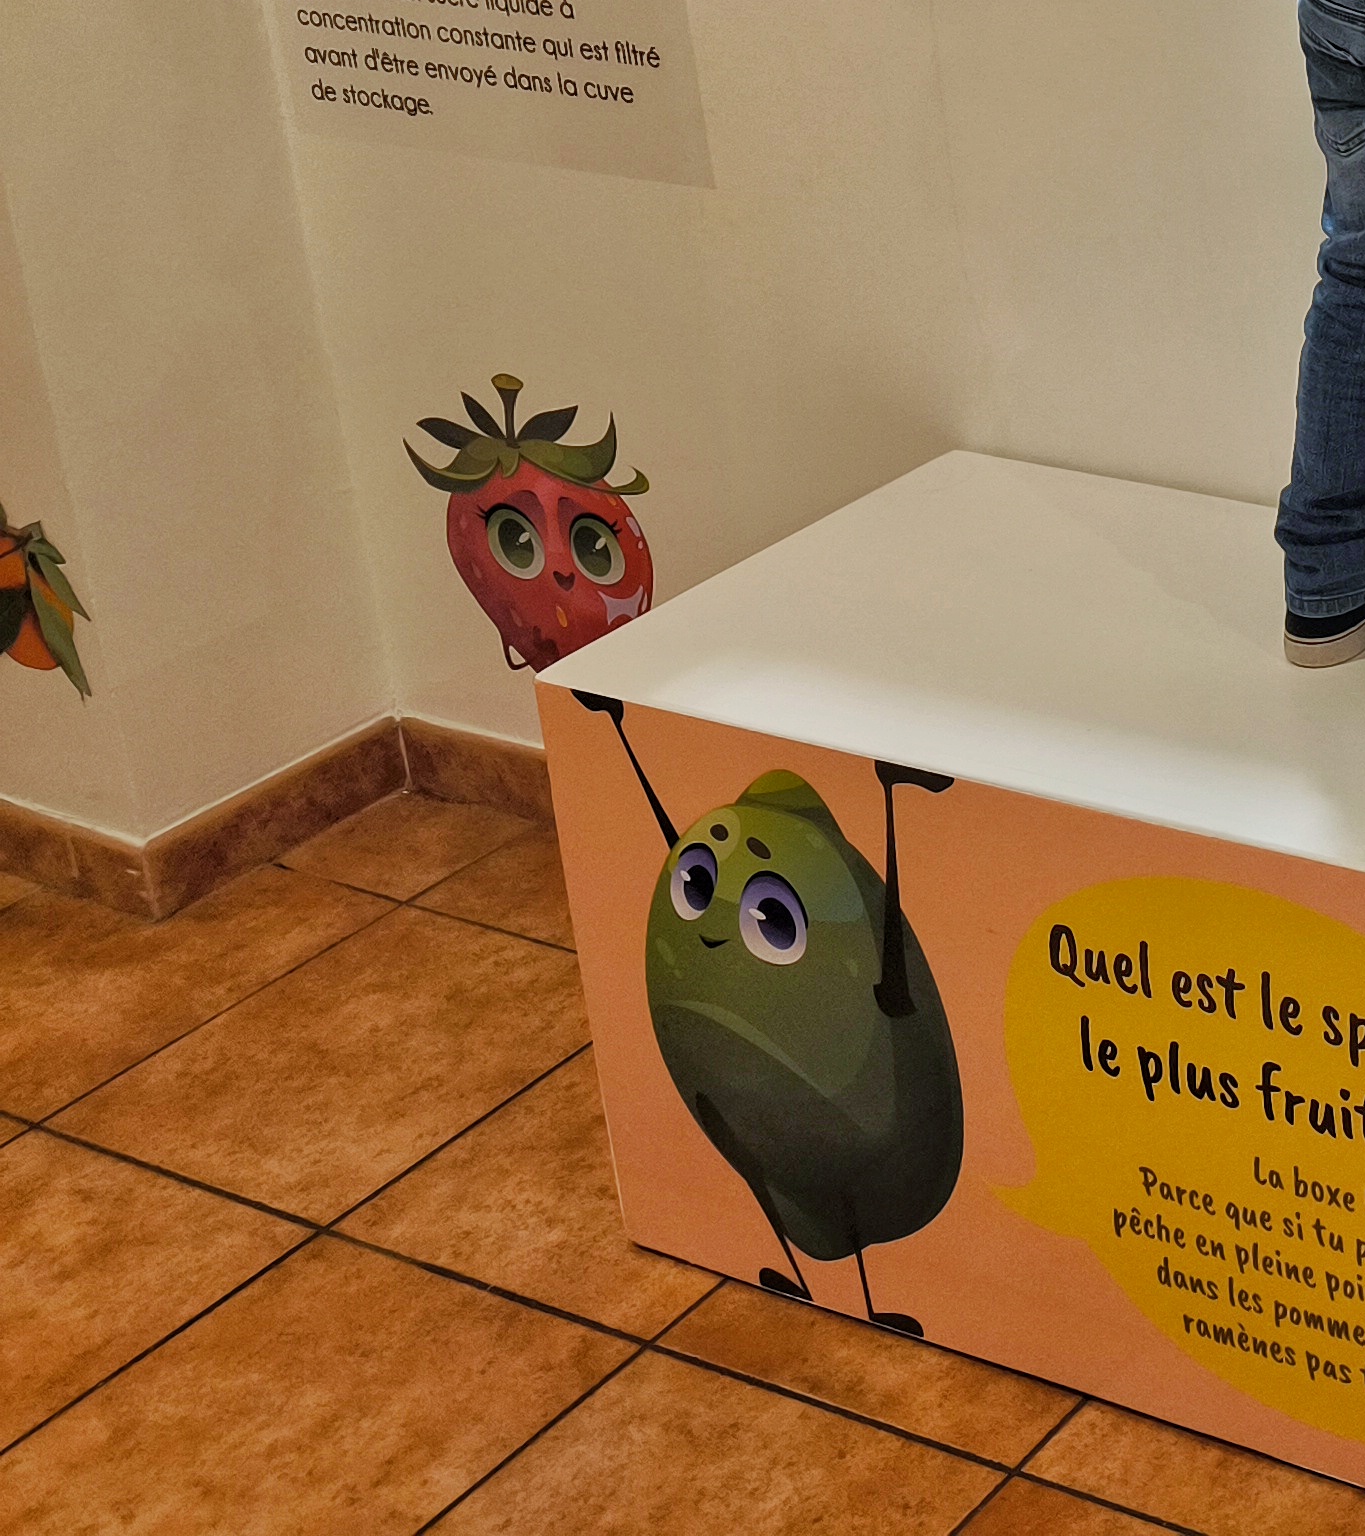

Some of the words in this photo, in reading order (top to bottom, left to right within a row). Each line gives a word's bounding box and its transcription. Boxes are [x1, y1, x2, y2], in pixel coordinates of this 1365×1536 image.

[296, 9, 432, 41] concentration
[436, 25, 537, 54] constante
[542, 37, 574, 61] qui
[579, 40, 609, 62] est
[614, 40, 661, 69] filtré
[304, 46, 358, 69] avant
[364, 47, 420, 77] d'être
[424, 61, 498, 89] envoyé
[503, 65, 553, 94] dans
[556, 71, 579, 97] la
[583, 81, 635, 104] cuve
[311, 78, 338, 103] de
[342, 84, 434, 117] stockage.
[1048, 923, 1153, 999] Quel
[1171, 967, 1246, 1020] est
[1260, 970, 1304, 1037] le
[1080, 1014, 1121, 1078] le
[1136, 1040, 1240, 1109] plus
[1138, 1165, 1217, 1217] Parce
[1224, 1201, 1273, 1232] que
[1282, 1211, 1304, 1241] si
[1311, 1217, 1345, 1254] tu
[1253, 1156, 1285, 1191] La
[1293, 1165, 1356, 1213] boxe
[1113, 1206, 1187, 1250] pêche
[1195, 1233, 1227, 1261] en
[1234, 1242, 1317, 1289] pleine
[1156, 1256, 1219, 1301] dans
[1227, 1276, 1264, 1315] les
[1182, 1313, 1297, 1367] ramènes
[1305, 1350, 1352, 1384] pas
